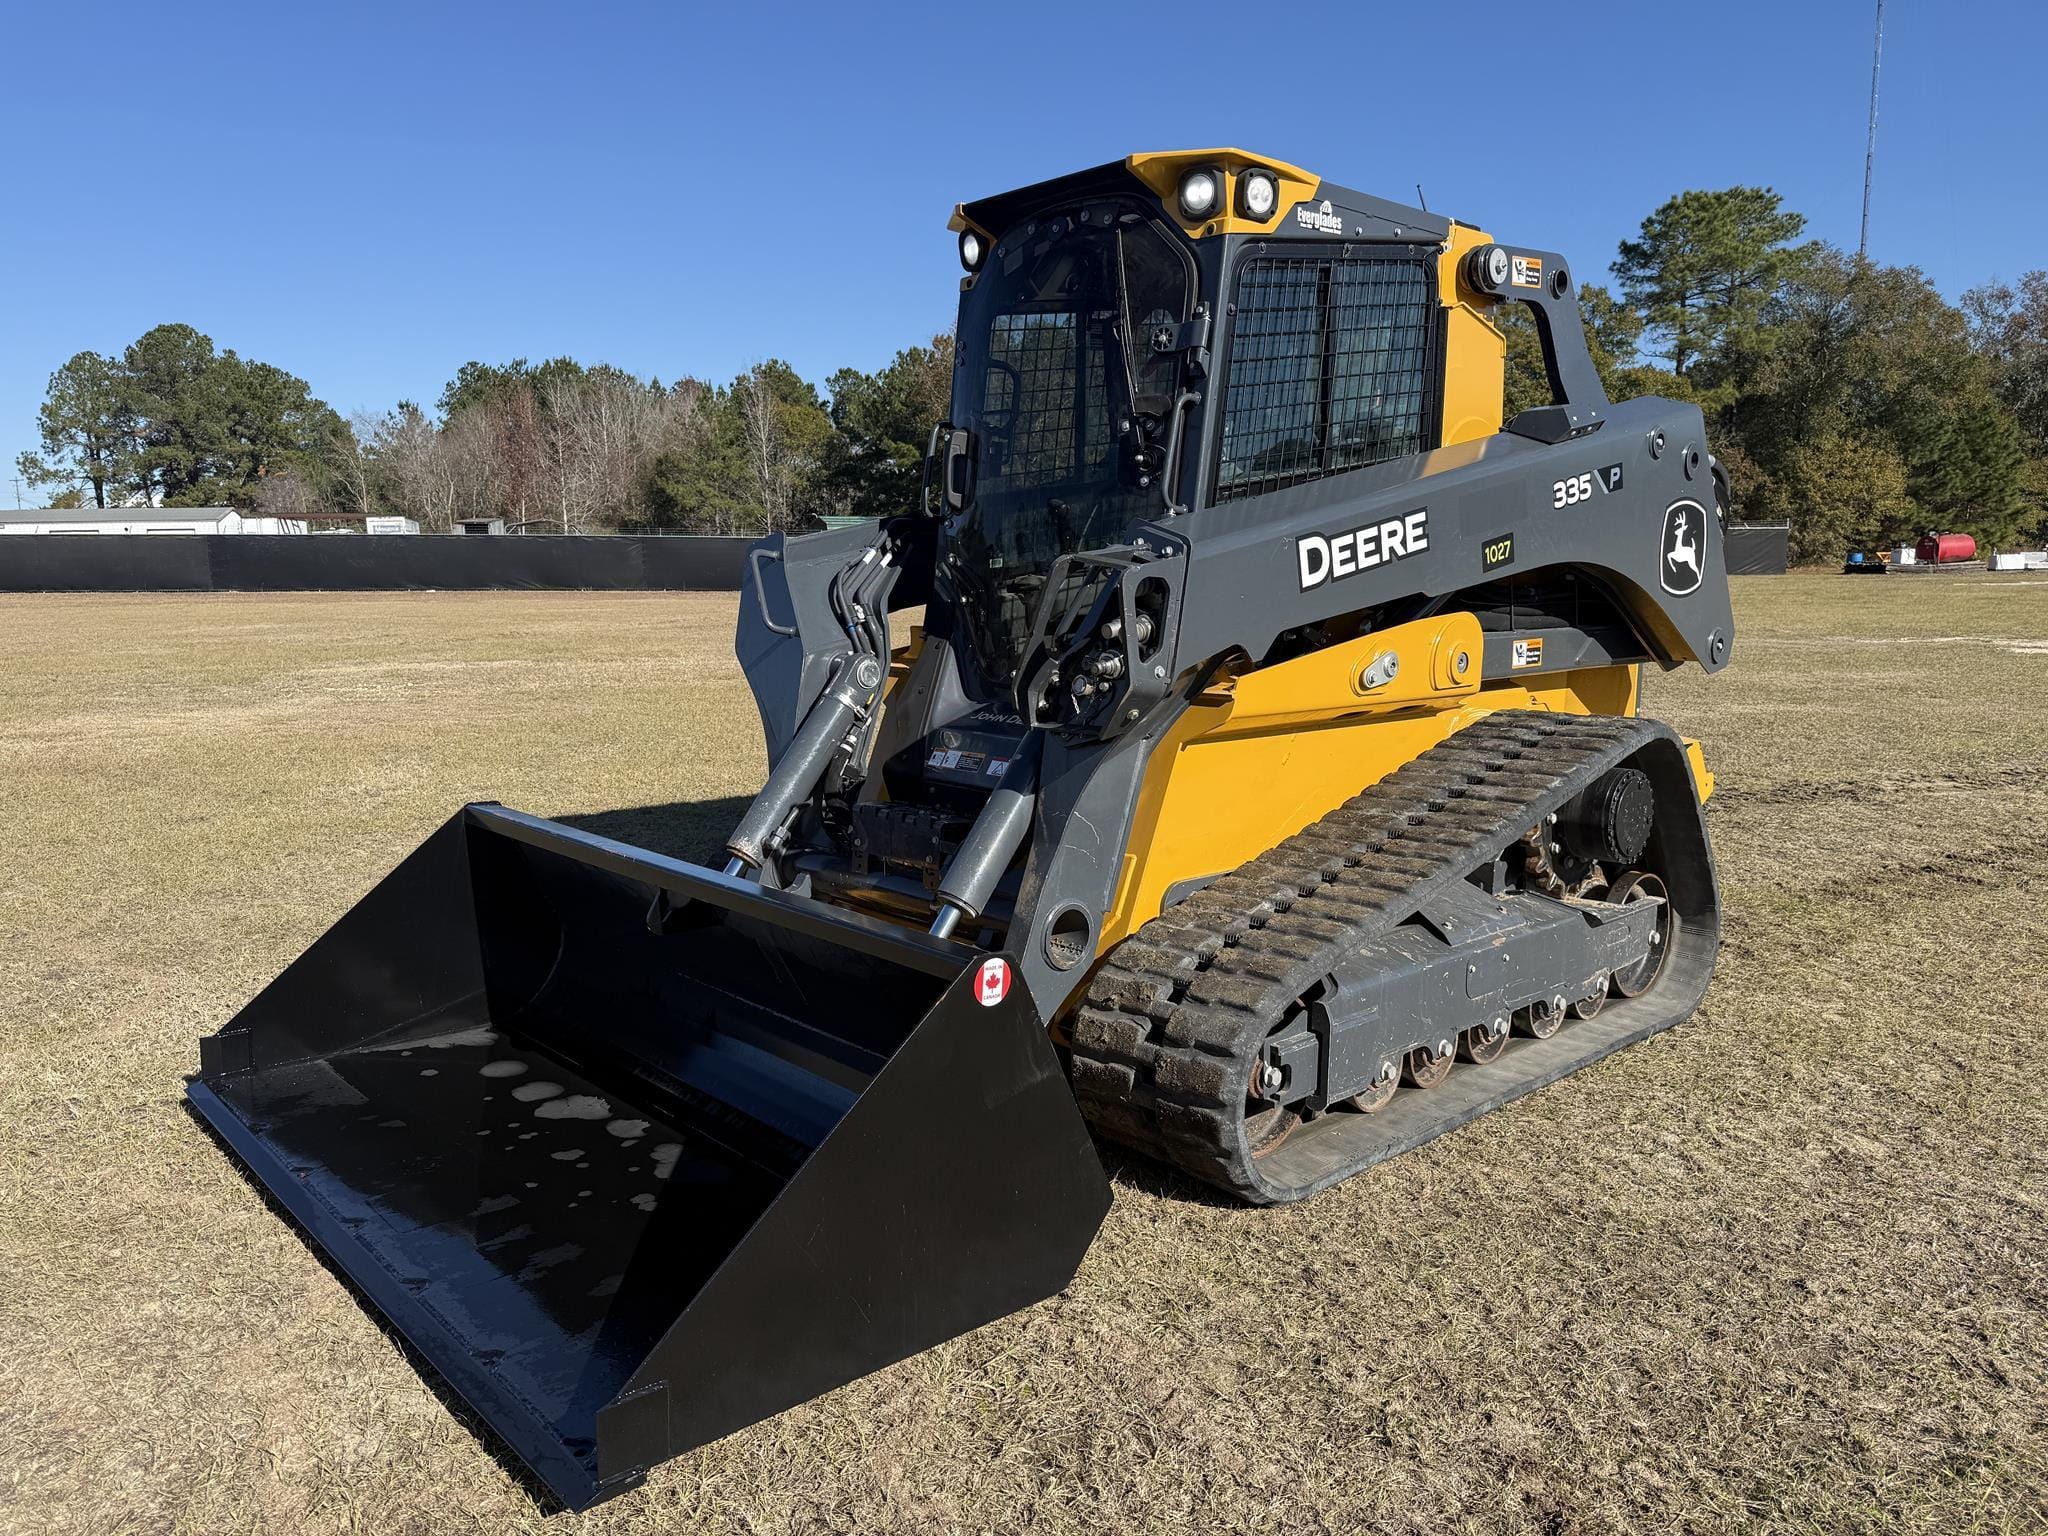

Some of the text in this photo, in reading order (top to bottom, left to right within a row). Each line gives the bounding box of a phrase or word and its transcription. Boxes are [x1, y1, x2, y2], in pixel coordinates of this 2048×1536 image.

[1297, 206, 1343, 230] Everglades
[1553, 472, 1592, 509] 335
[1297, 510, 1429, 590] DEERE
[1484, 540, 1511, 565] 1027
[970, 711, 1008, 722] JOHN
[983, 993, 1001, 1001] CANADA
